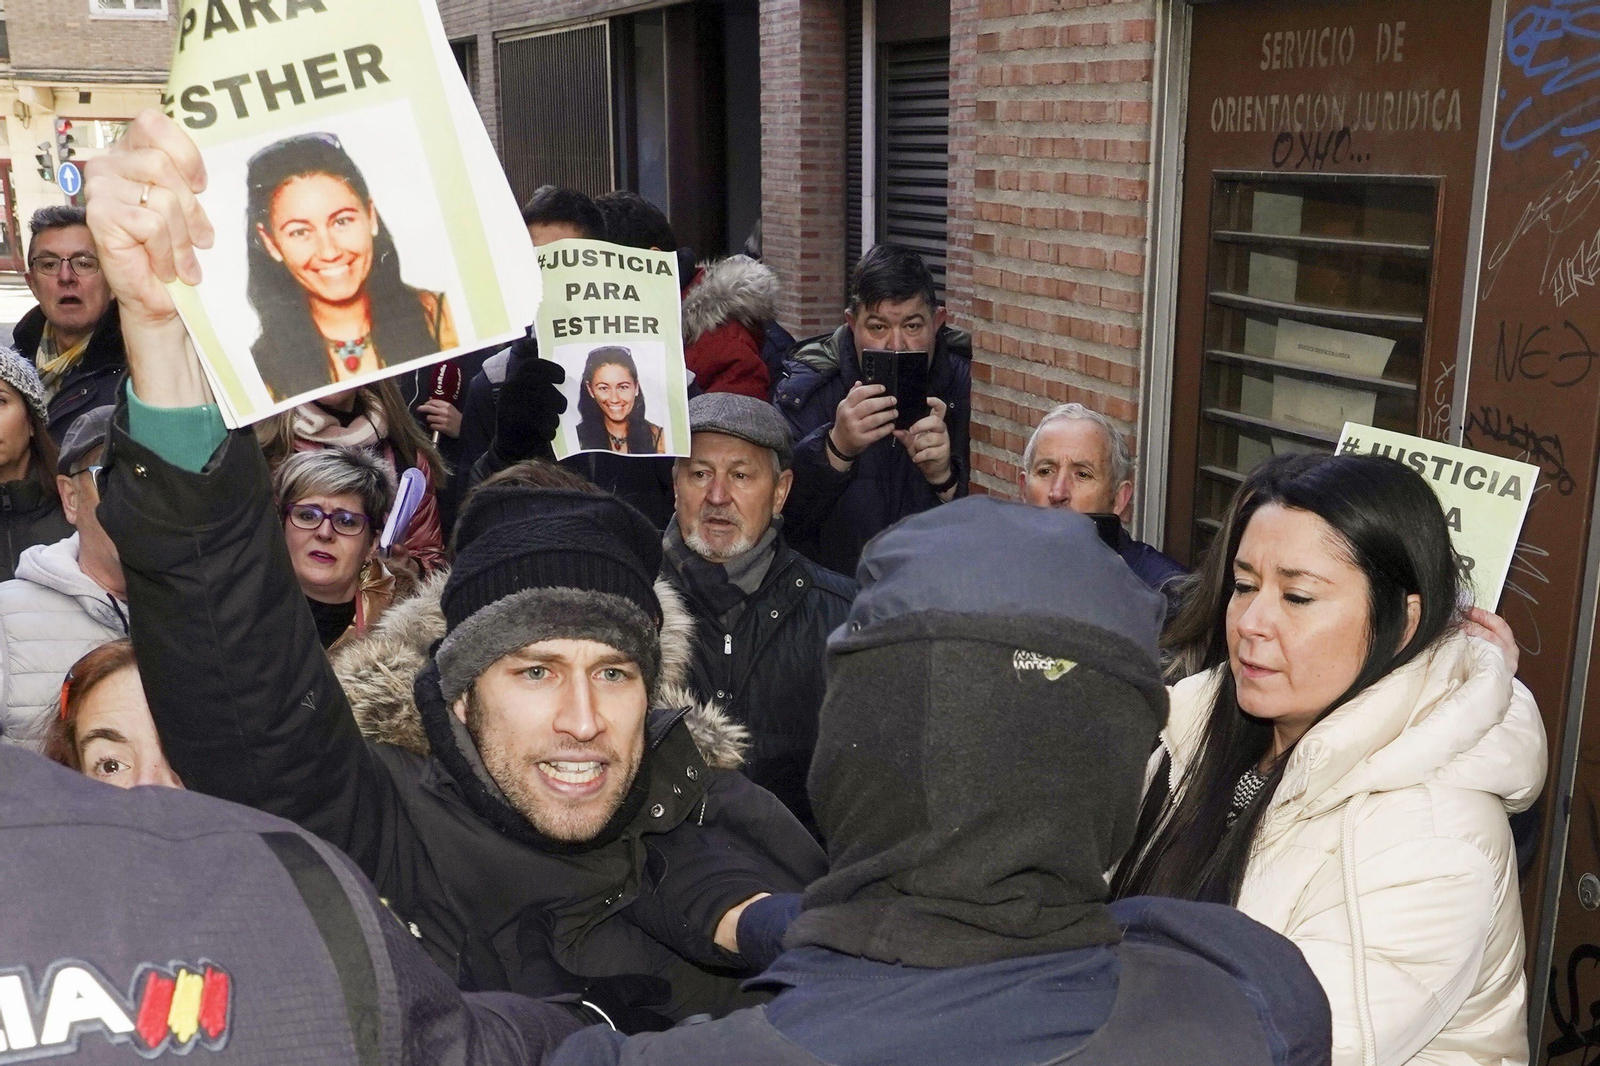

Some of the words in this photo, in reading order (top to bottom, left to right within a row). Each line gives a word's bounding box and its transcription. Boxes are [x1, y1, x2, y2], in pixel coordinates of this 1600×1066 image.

[1260, 25, 1355, 70] SERVICIO
[1375, 21, 1407, 63] DE
[537, 248, 673, 276] #JUSTICIA
[565, 282, 640, 301] PARA
[552, 315, 660, 338] ESTHER
